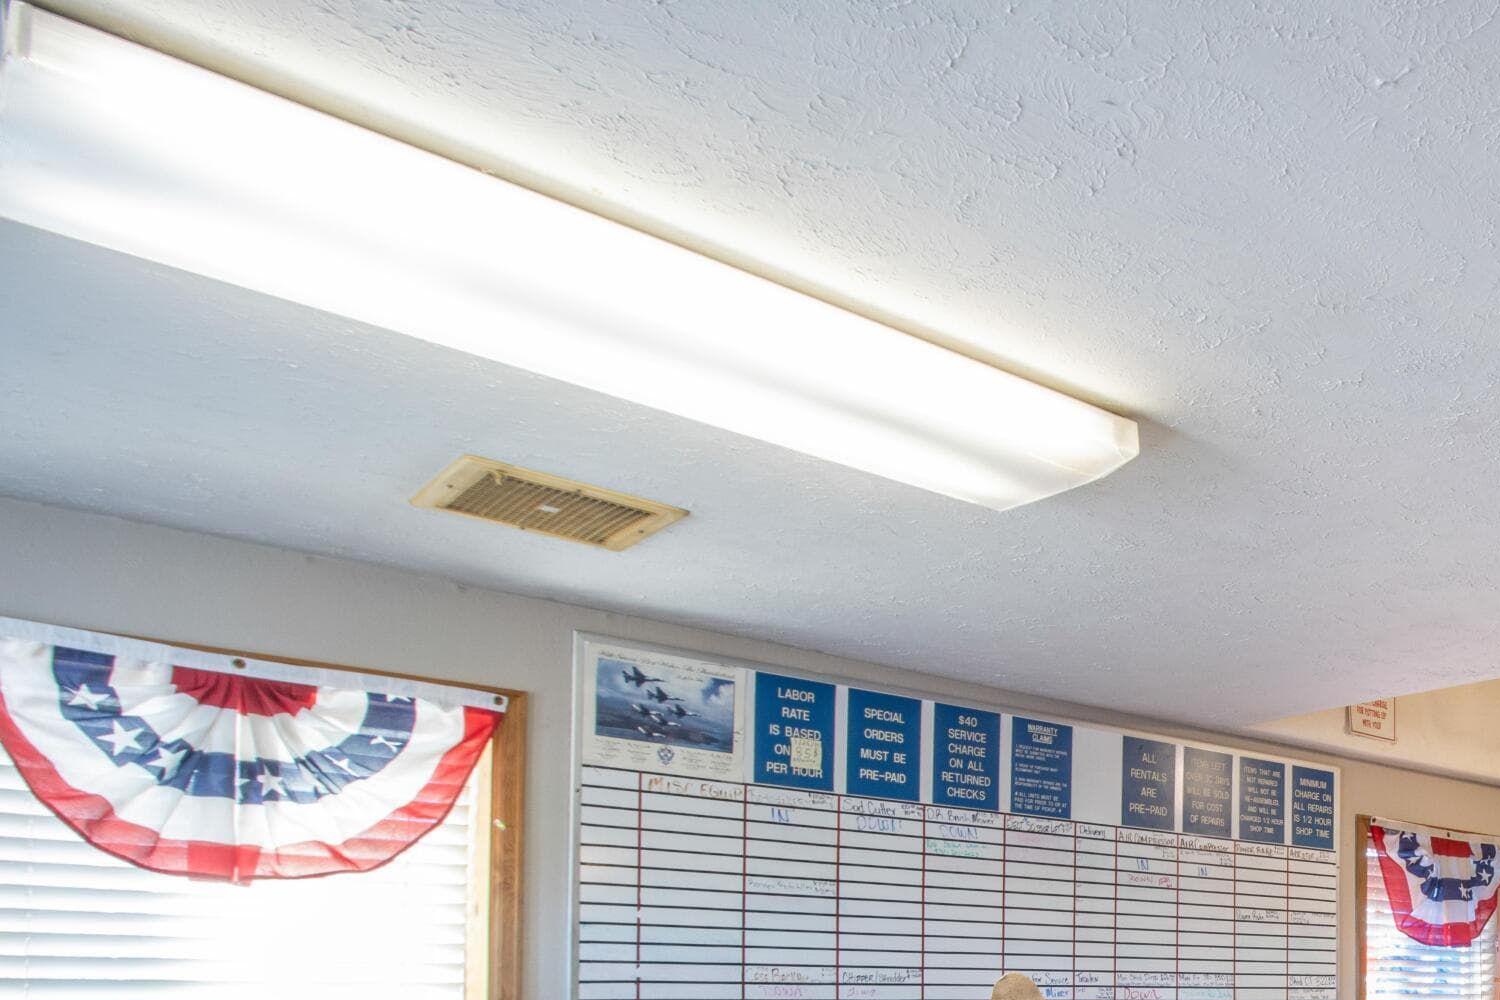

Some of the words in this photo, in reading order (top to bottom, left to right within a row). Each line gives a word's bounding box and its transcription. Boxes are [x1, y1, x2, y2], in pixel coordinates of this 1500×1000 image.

[778, 687, 815, 703] LABOR
[782, 707, 810, 721] RATE
[864, 708, 905, 724] SPECIAL
[958, 715, 977, 727] $40
[769, 724, 780, 735] IS
[785, 727, 821, 741] BASED
[864, 729, 904, 743] ORDERS
[948, 728, 987, 743] SERVICE
[1027, 724, 1058, 736] WARRANTY
[774, 744, 790, 756] ON
[861, 748, 888, 761] MUST
[893, 753, 906, 764] BE
[948, 743, 986, 758] CHARGE
[949, 758, 963, 768] ON
[967, 761, 984, 772] ALL
[1142, 752, 1157, 764] ALL
[766, 762, 788, 774] PER
[793, 766, 823, 778] HOUR
[1210, 762, 1226, 771] LEFT
[860, 768, 906, 784] PRE-PAID
[942, 772, 991, 787] RETURNED
[1130, 768, 1167, 782] RENTALS
[1300, 778, 1327, 789] MINIMUM
[947, 787, 986, 801] CHECKS
[1140, 787, 1157, 798] ARE
[1215, 791, 1229, 800] SOLD
[1295, 789, 1320, 801] CHARGE
[1322, 794, 1331, 802] ON
[1129, 802, 1167, 817] PRE-PAID
[1191, 800, 1204, 810] FOR
[1207, 803, 1223, 813] COST
[1294, 802, 1305, 811] ALL
[1308, 804, 1332, 814] REPAIRS
[1190, 815, 1198, 823] OF
[1200, 816, 1225, 827] REPAIRS
[1294, 814, 1300, 822] IS
[1302, 815, 1312, 824] 1/2
[1314, 817, 1332, 826] HOUR
[1295, 827, 1313, 835] SHOP
[1316, 829, 1330, 838] TIME
